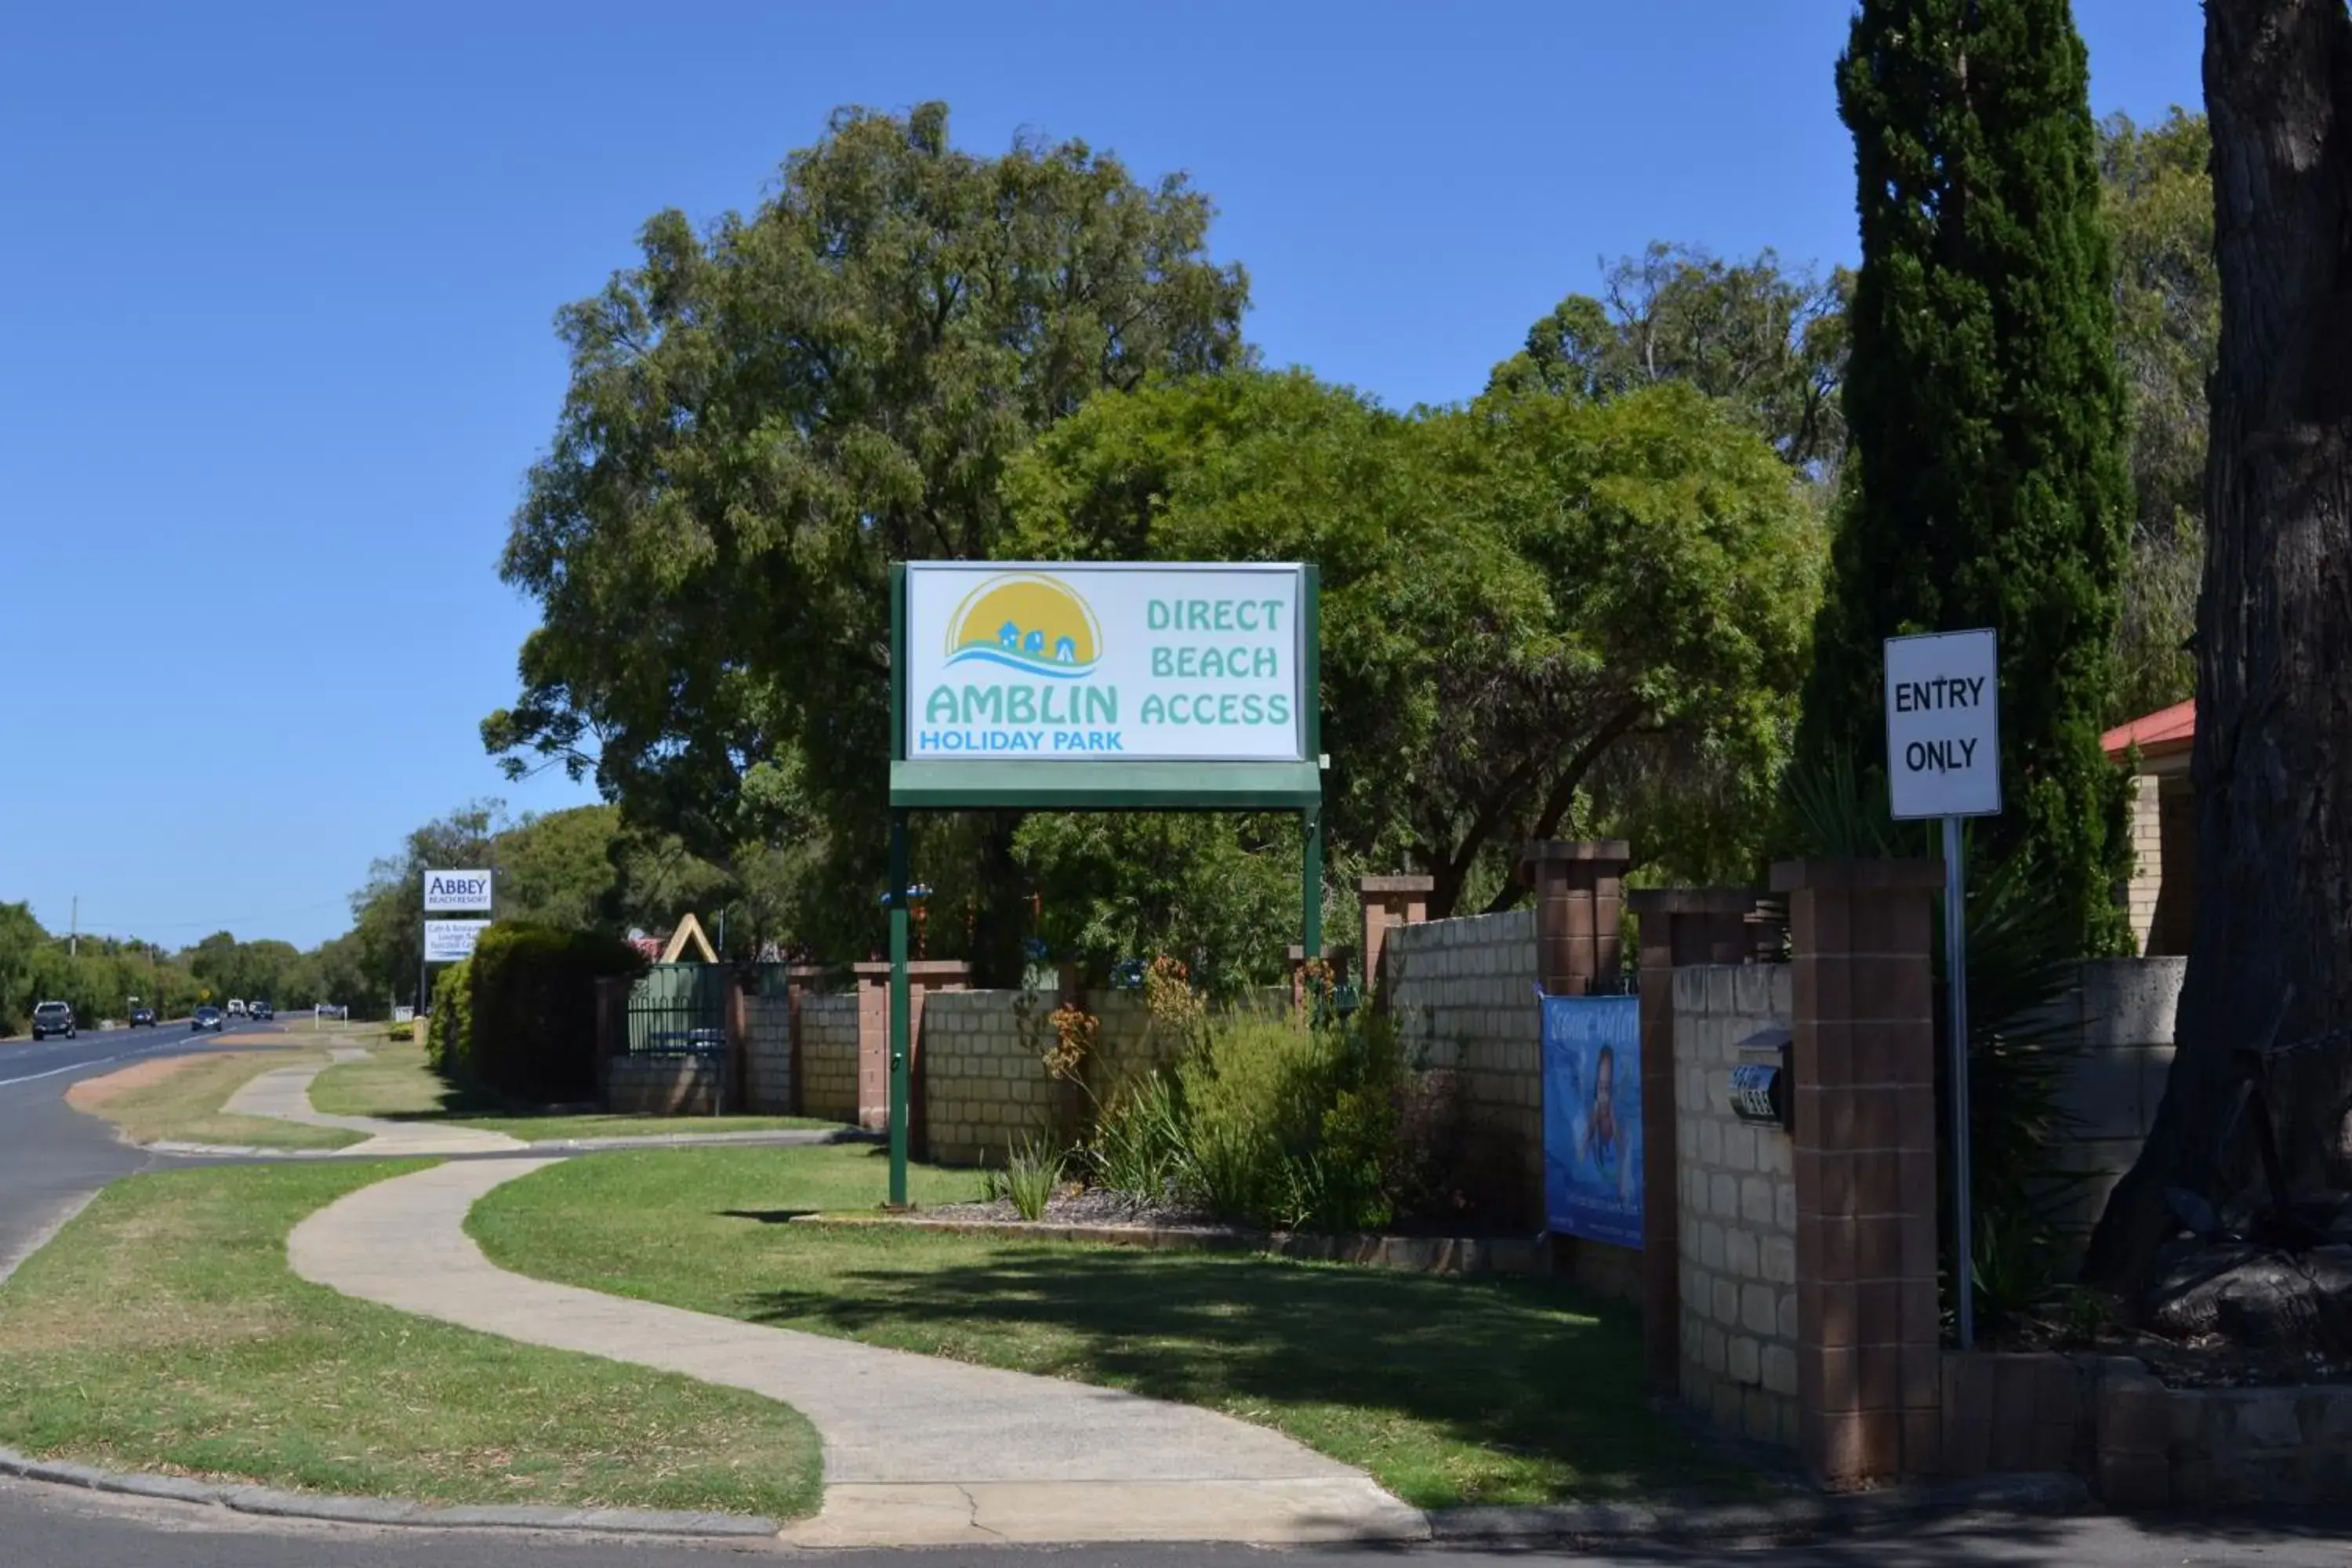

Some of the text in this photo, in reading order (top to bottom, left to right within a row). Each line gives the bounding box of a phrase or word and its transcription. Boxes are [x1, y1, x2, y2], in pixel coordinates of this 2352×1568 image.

[1148, 600, 1283, 630] DIRECT
[1152, 647, 1277, 678] BEACH
[925, 684, 1119, 724] AMBLIN
[1140, 694, 1290, 725] ACCESS
[1896, 677, 1985, 712] ENTRY
[920, 730, 1123, 751] HOLIDAY PARK
[1906, 738, 1977, 771] ONLY
